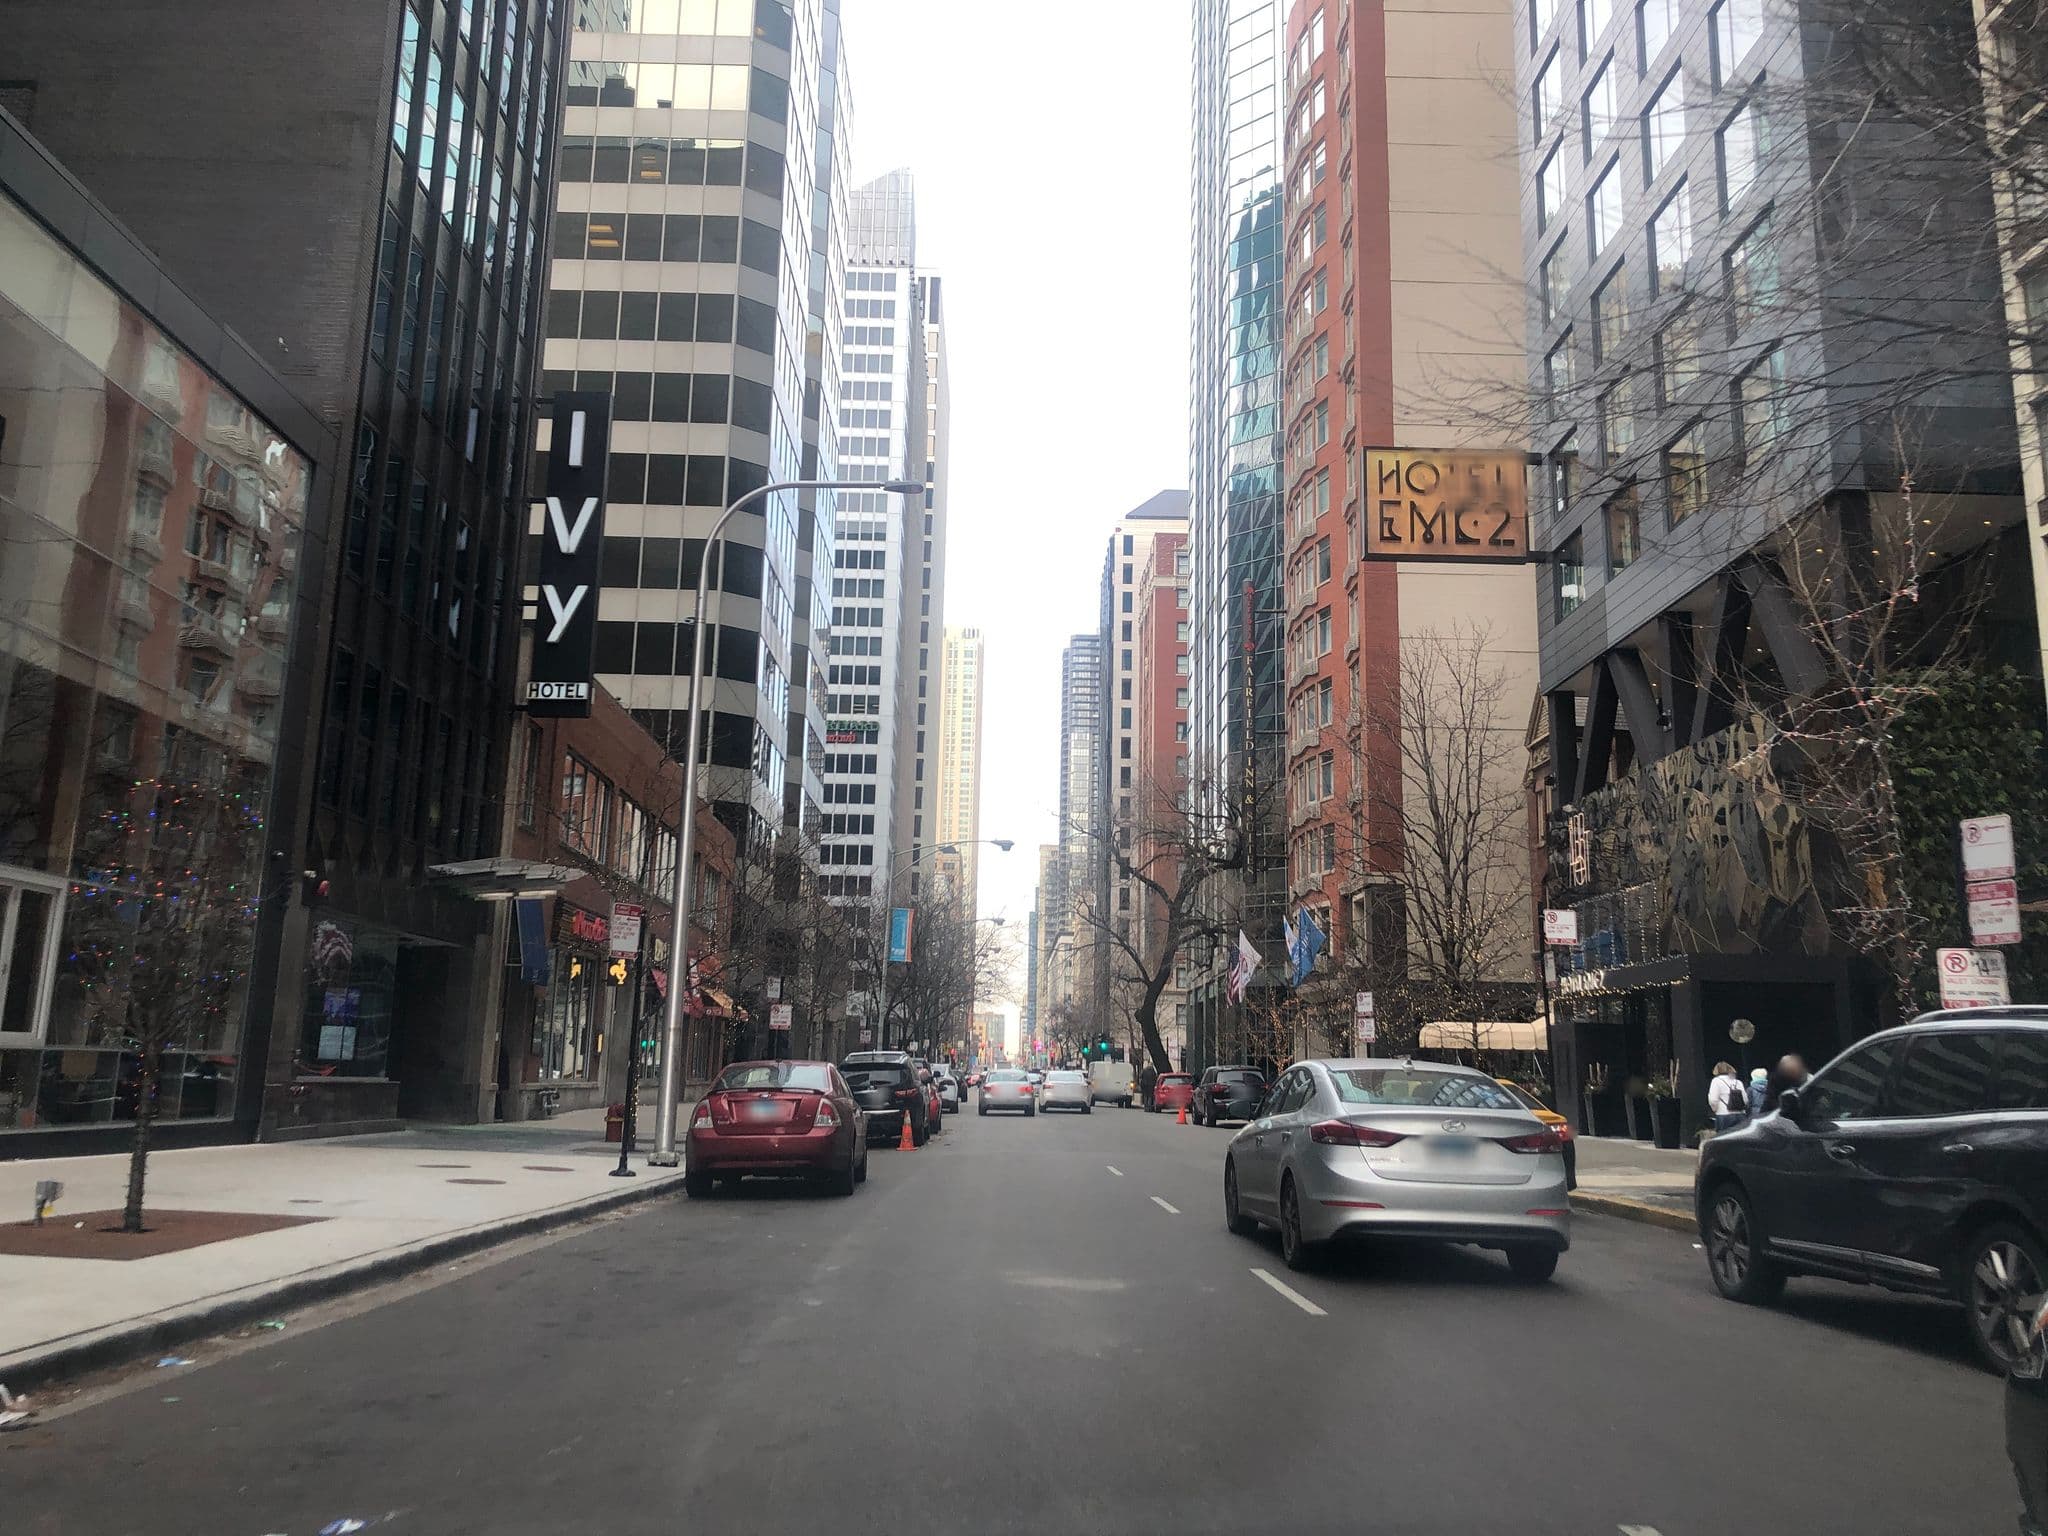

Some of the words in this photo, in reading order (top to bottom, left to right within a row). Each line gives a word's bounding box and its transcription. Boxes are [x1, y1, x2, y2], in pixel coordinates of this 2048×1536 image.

[1378, 459, 1508, 497] HOE
[528, 683, 586, 699] HOTEL
[1245, 655, 1255, 750] FAIRFIELD
[1245, 756, 1255, 788] INN
[1244, 794, 1255, 805] &
[1245, 811, 1255, 875] SUITES
